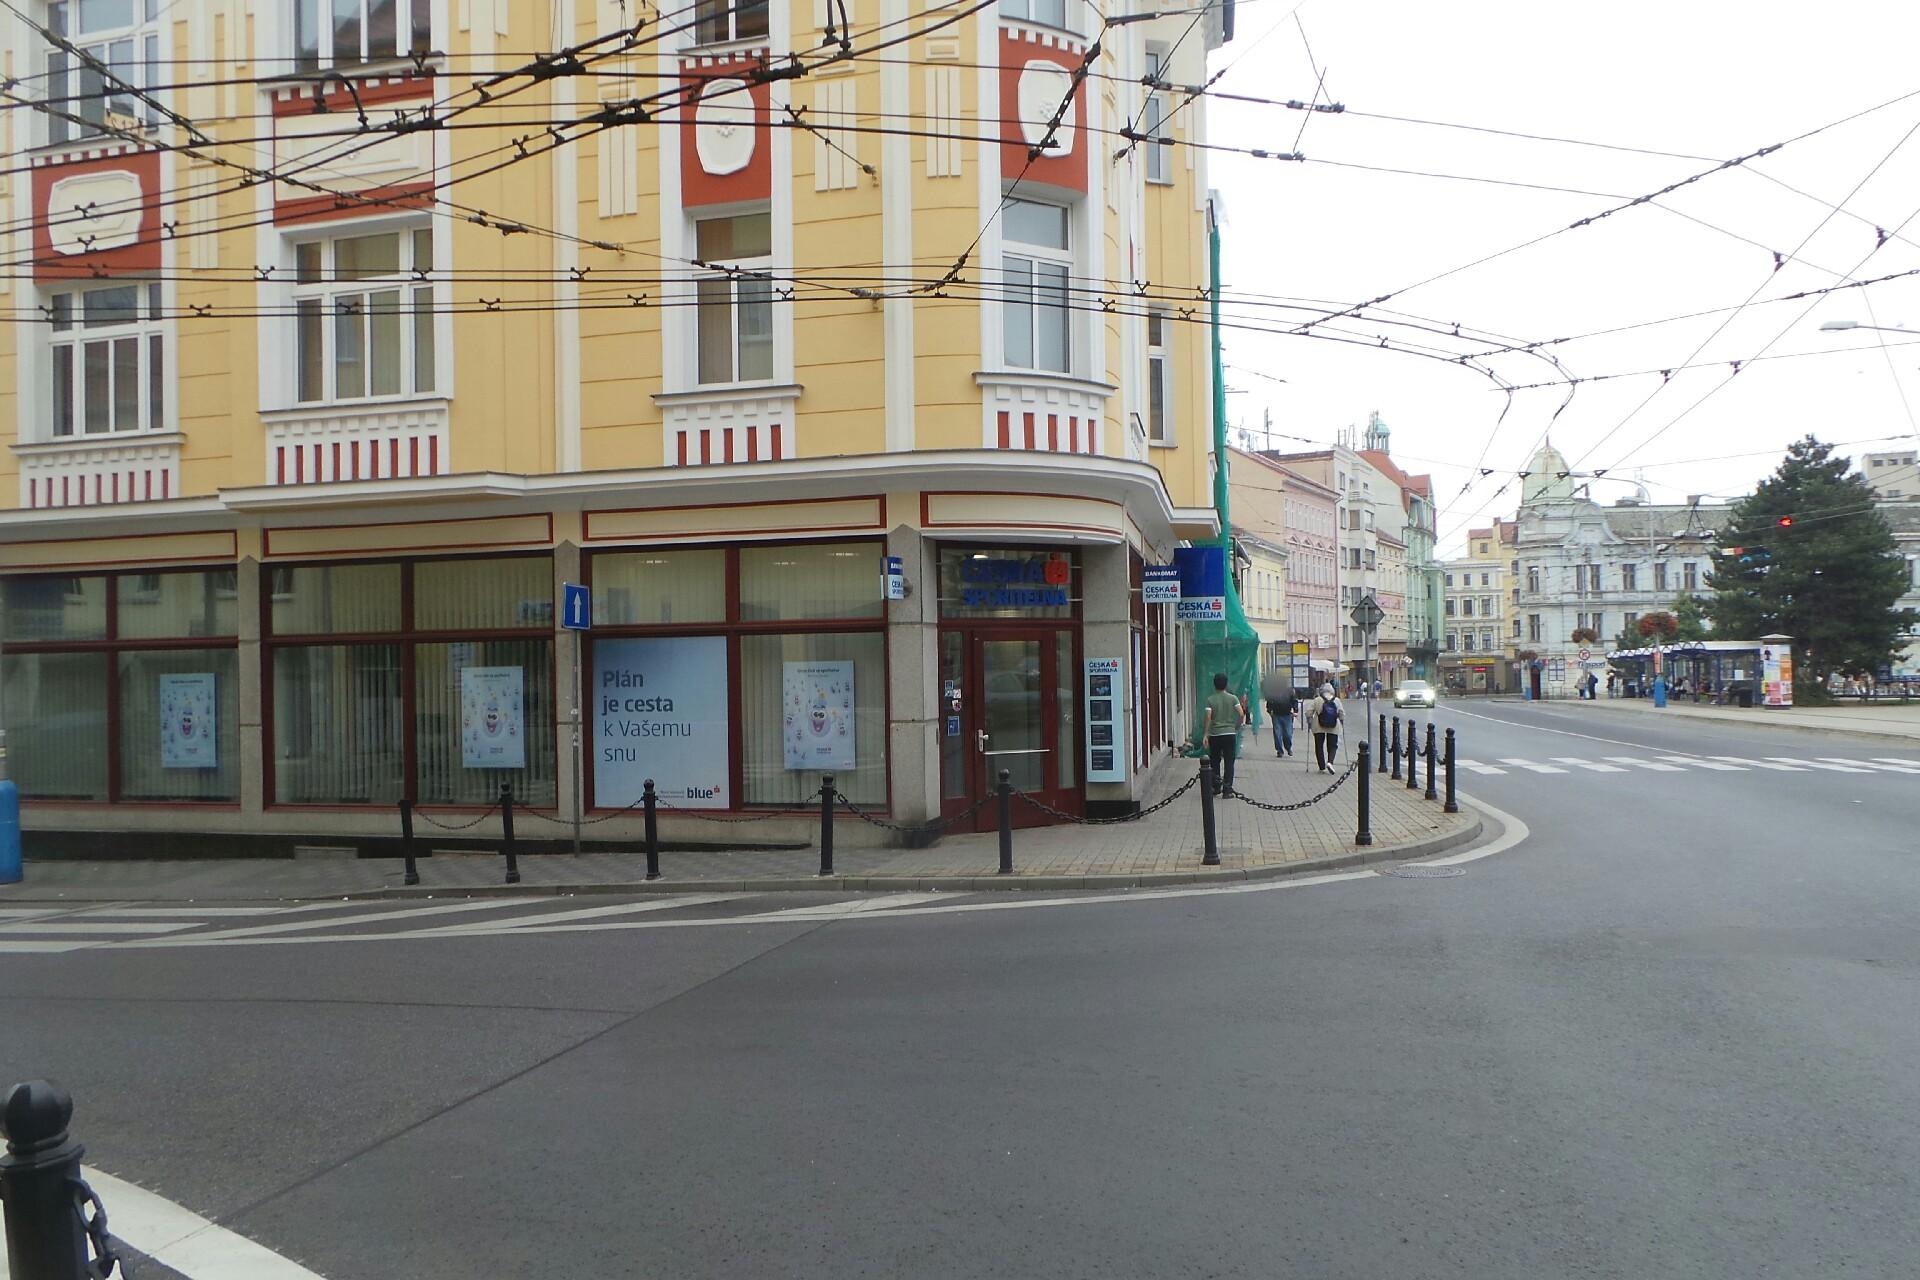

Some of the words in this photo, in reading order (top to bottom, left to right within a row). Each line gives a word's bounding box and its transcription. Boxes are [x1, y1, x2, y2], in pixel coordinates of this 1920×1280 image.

[1145, 585, 1171, 594] ČESKÁ
[1177, 599, 1211, 611] ČESKÁ
[1177, 611, 1222, 619] SPOŘITELNA
[602, 669, 644, 688] Plán
[602, 695, 619, 716] je
[624, 695, 674, 713] cesta
[604, 719, 614, 737] k
[618, 719, 691, 737] Vašemu
[604, 747, 636, 762] snu
[687, 786, 713, 799] blue
